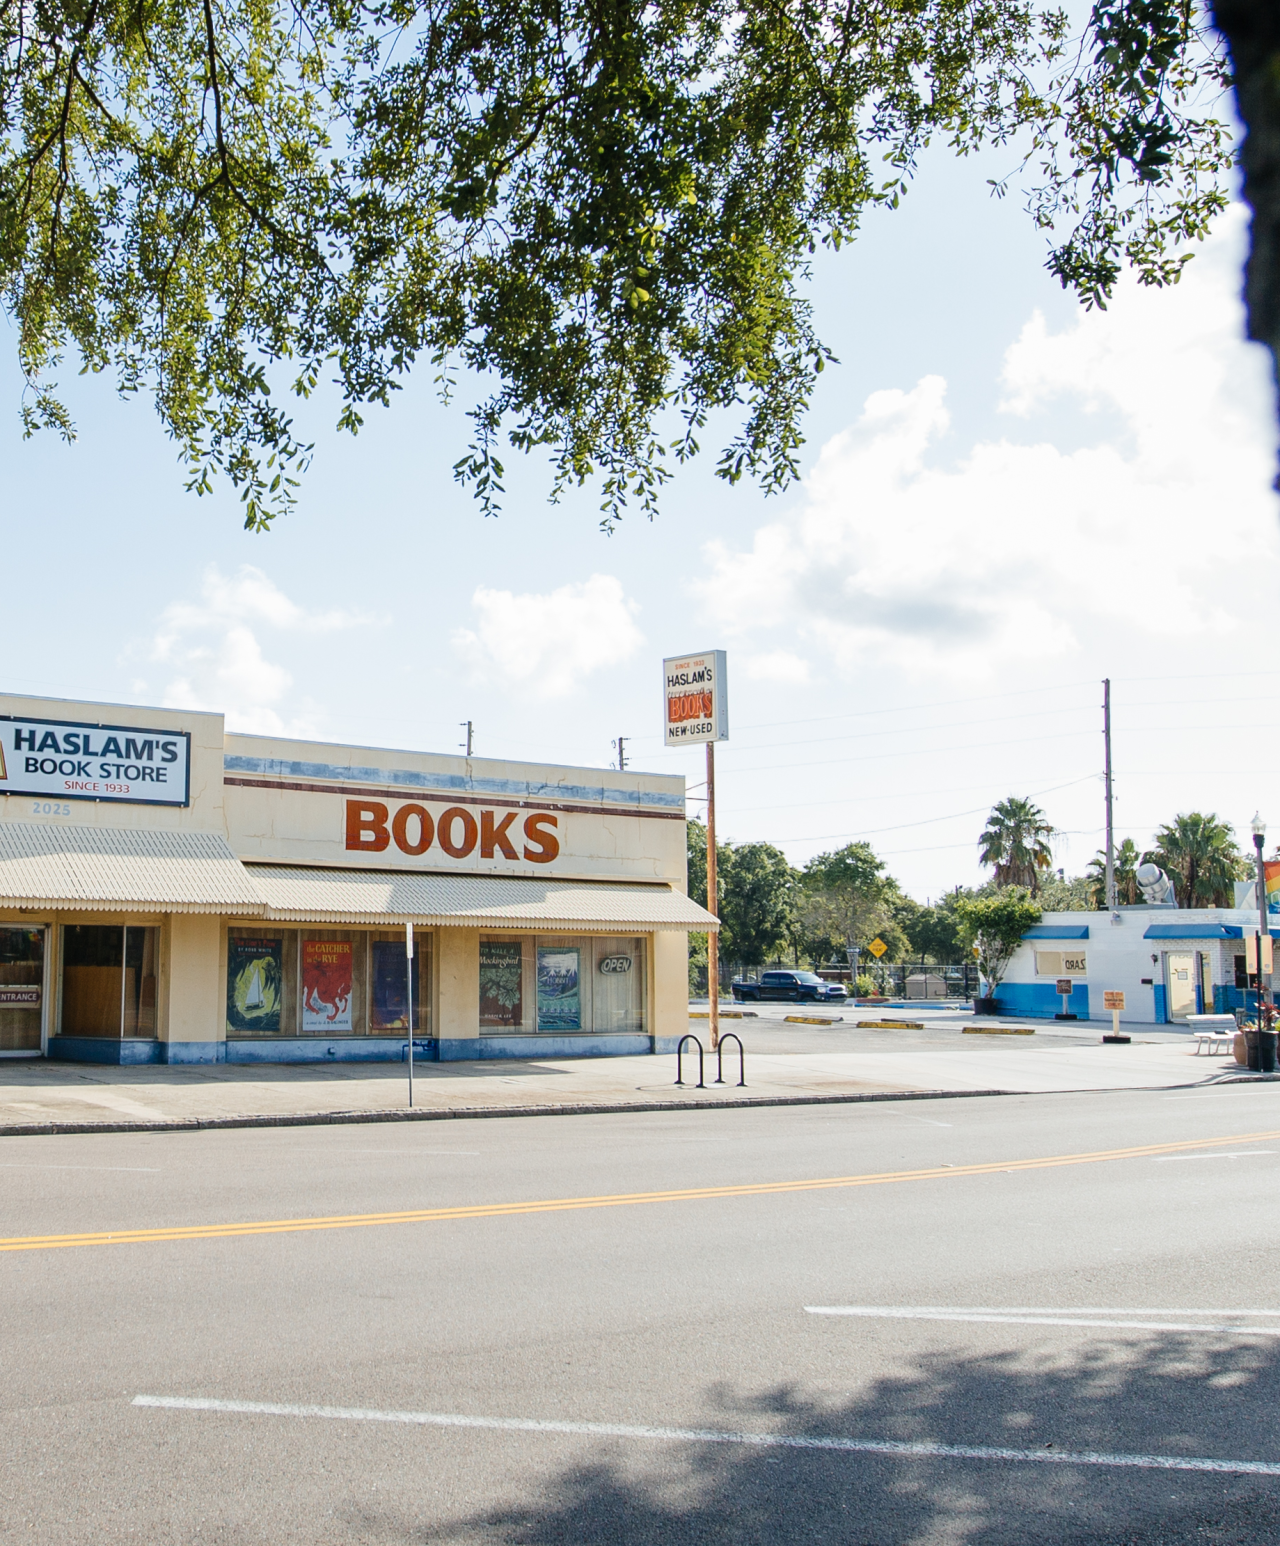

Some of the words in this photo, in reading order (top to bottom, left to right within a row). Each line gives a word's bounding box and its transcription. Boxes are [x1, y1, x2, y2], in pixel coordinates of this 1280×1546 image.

[675, 662, 691, 670] SINCE
[668, 666, 713, 687] HASLAM'S
[670, 693, 712, 719] BOOKS
[13, 727, 179, 764] HASLAM'S
[24, 756, 93, 778] BOOK
[99, 762, 168, 784] STORE
[64, 780, 100, 792] SINCE
[103, 782, 131, 794] 1933
[33, 801, 71, 816] 2025
[345, 798, 560, 864] BOOKS
[306, 944, 315, 952] the
[315, 943, 350, 953] CATCHER
[322, 954, 338, 963] RYE
[480, 956, 519, 968] Mockingbird
[603, 958, 630, 972] OPEN
